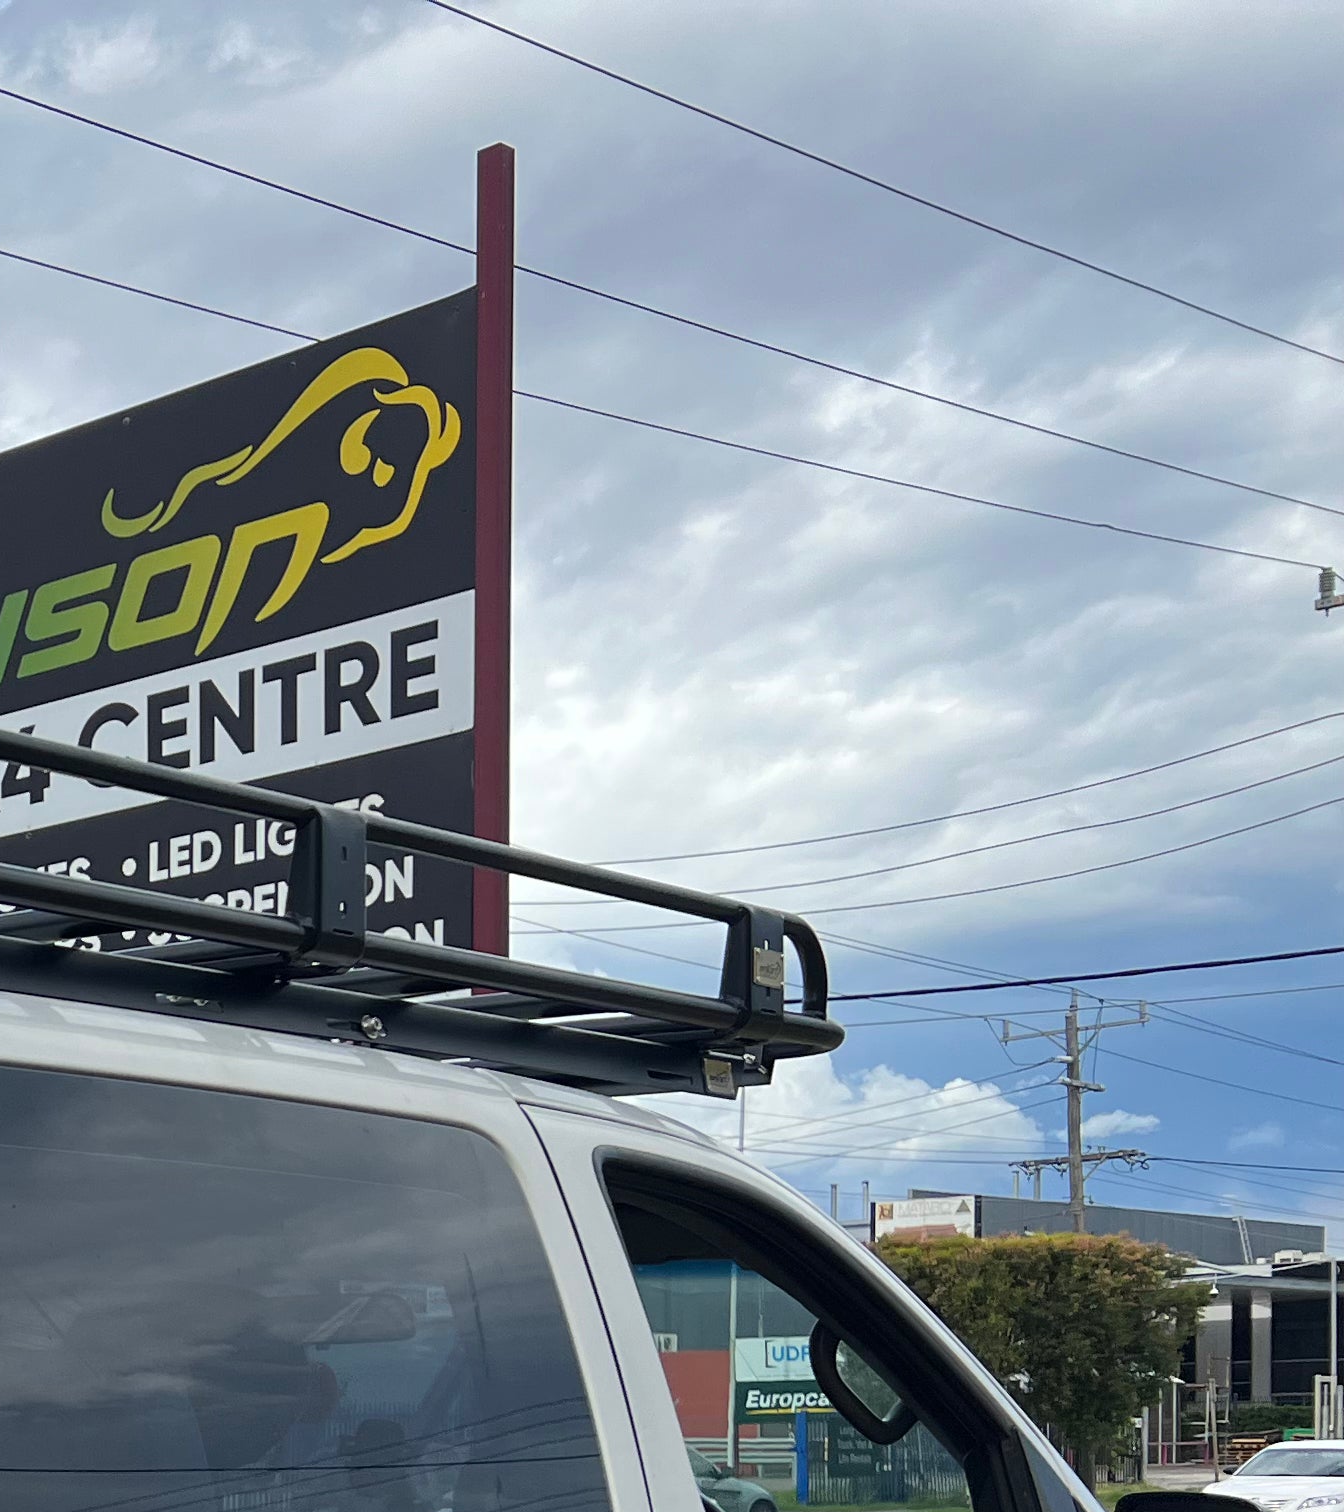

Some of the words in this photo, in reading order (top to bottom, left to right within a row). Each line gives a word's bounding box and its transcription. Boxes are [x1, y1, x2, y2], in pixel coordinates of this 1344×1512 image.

[78, 619, 439, 787] CENTRE
[149, 831, 222, 882] LED
[746, 1389, 833, 1413] Europca
